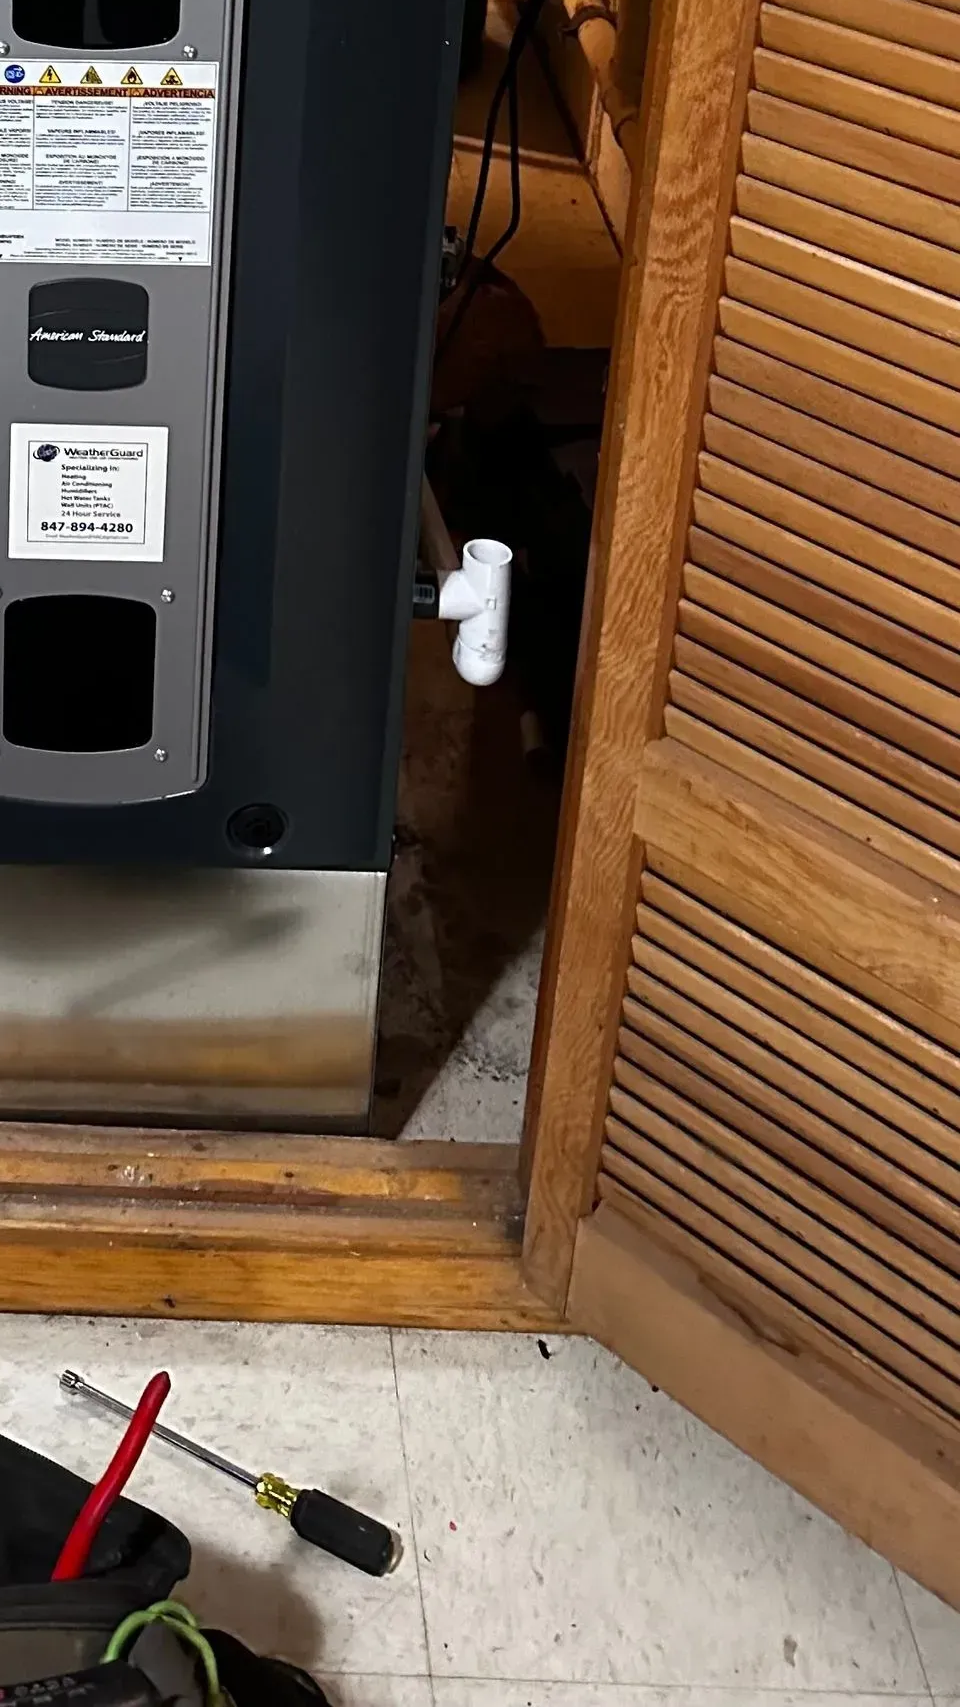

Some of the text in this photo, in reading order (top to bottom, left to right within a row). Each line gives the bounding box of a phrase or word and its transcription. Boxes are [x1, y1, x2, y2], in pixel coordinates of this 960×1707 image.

[46, 87, 127, 97] AVERTISSEMENT
[143, 88, 215, 98] ADVERTENCIA
[29, 327, 146, 342] American Standard
[63, 447, 144, 457] WeatherGuard
[61, 463, 108, 472] Specializing
[93, 510, 121, 518] Service
[40, 521, 134, 533] 847-894-4280
